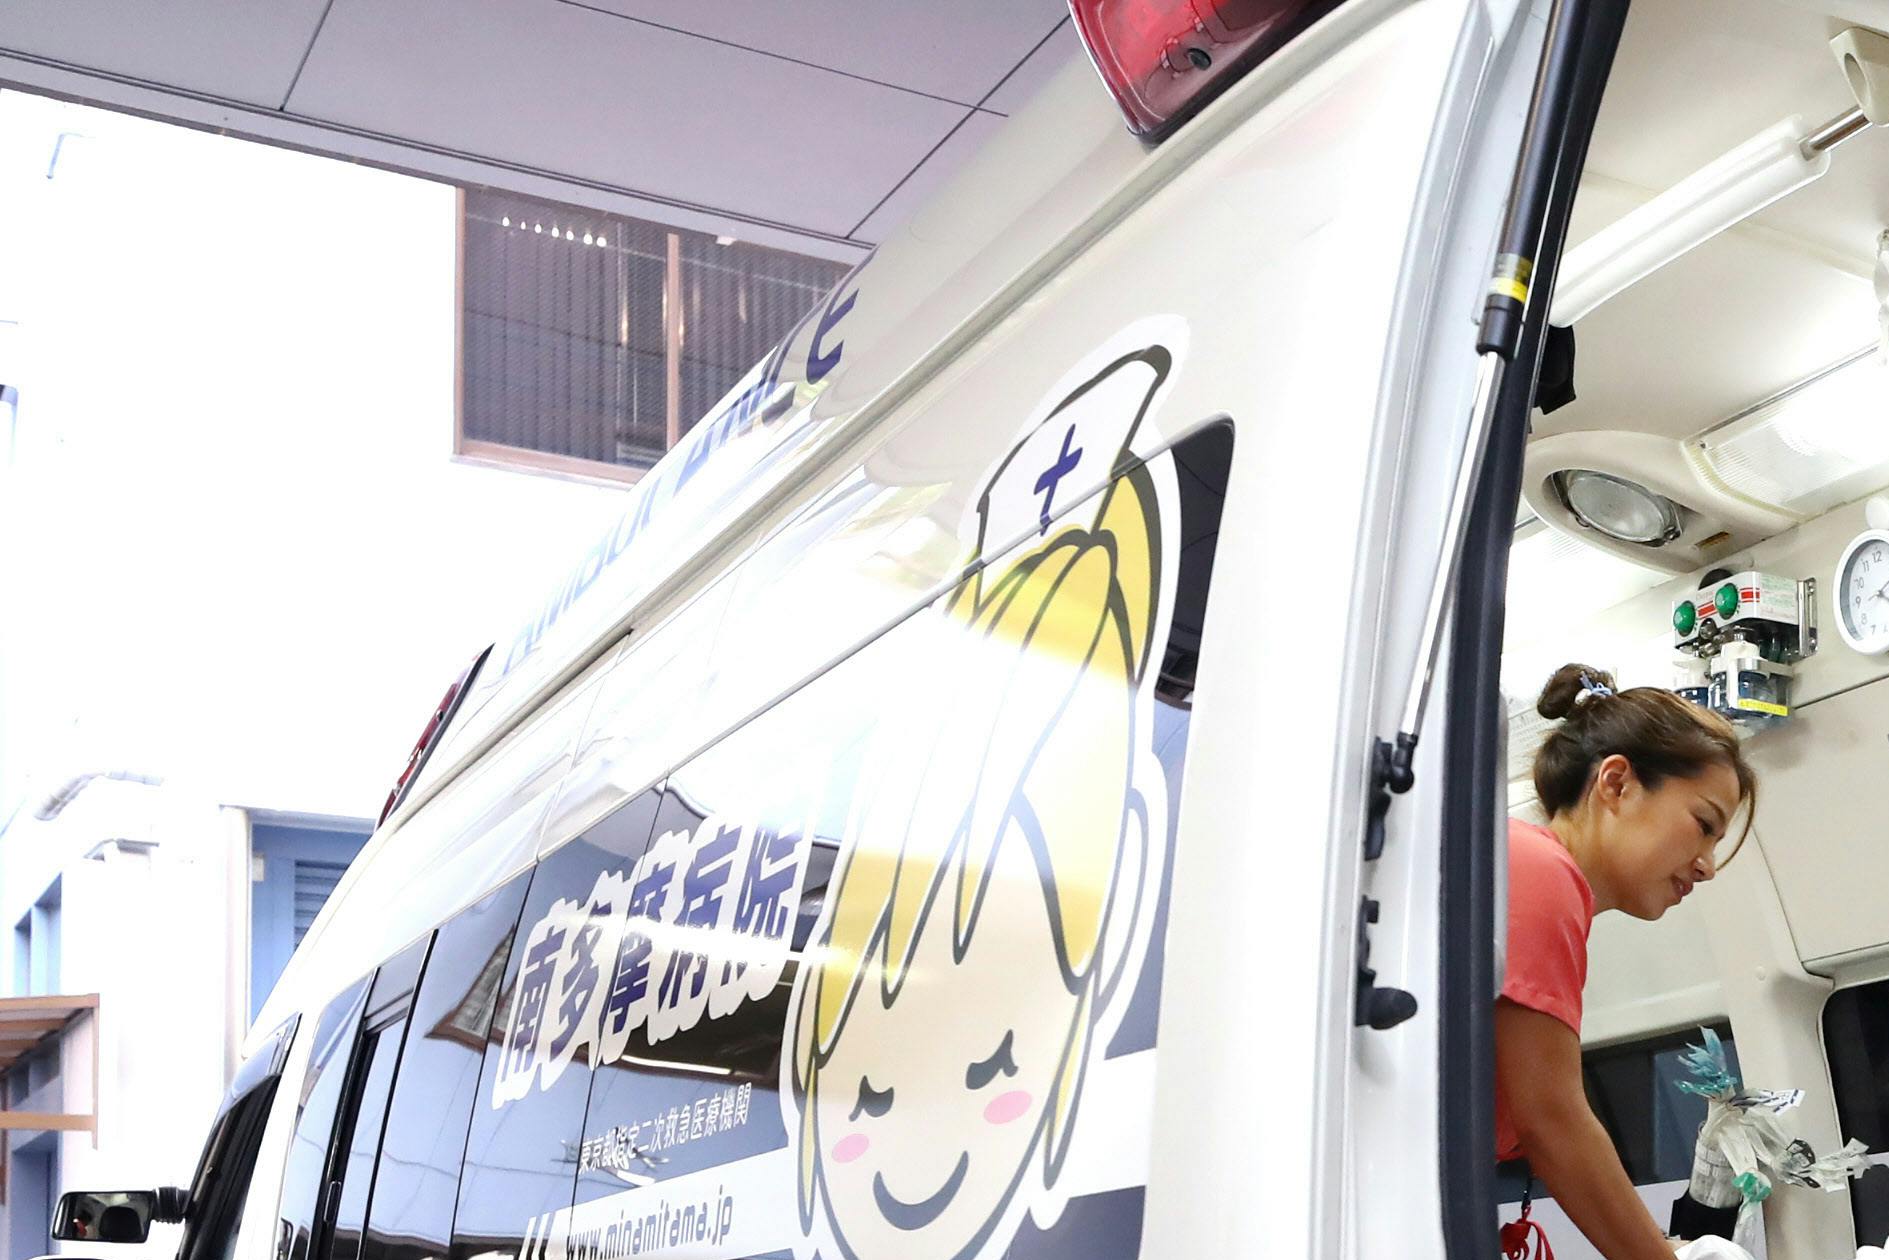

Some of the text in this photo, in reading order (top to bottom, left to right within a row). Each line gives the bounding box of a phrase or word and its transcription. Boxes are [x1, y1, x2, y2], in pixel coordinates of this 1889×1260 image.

[1871, 551, 1883, 563] 12
[1862, 560, 1870, 573] 11
[1855, 596, 1862, 608] 9
